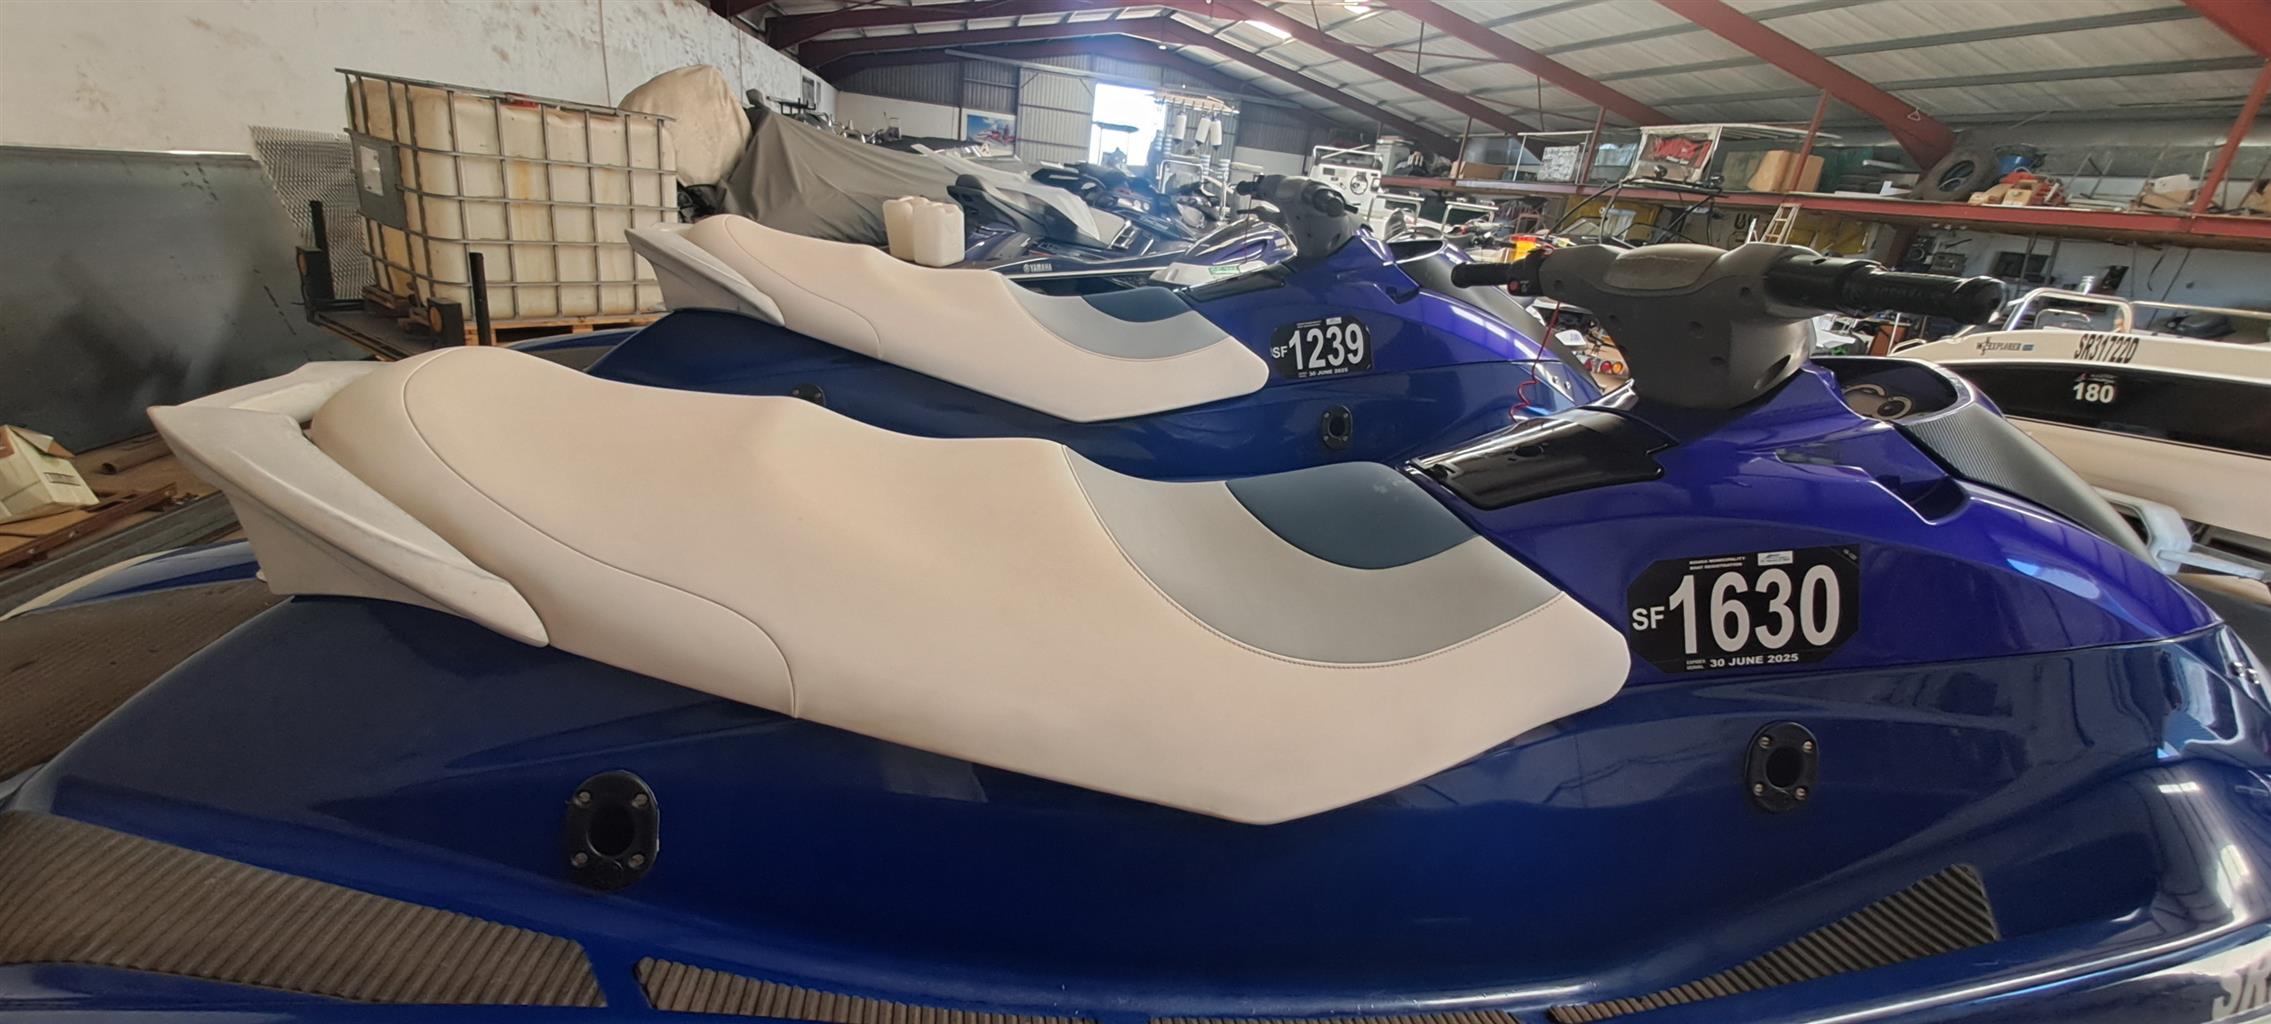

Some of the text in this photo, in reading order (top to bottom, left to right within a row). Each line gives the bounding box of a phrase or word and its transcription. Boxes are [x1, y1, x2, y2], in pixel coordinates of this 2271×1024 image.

[1271, 323, 1364, 370] SF 1239
[2073, 382, 2115, 404] 180
[1632, 564, 1840, 655] SF 1630
[1709, 658, 1725, 668] 30
[1728, 655, 1764, 667] JUNE
[1767, 653, 1799, 664] 2025
